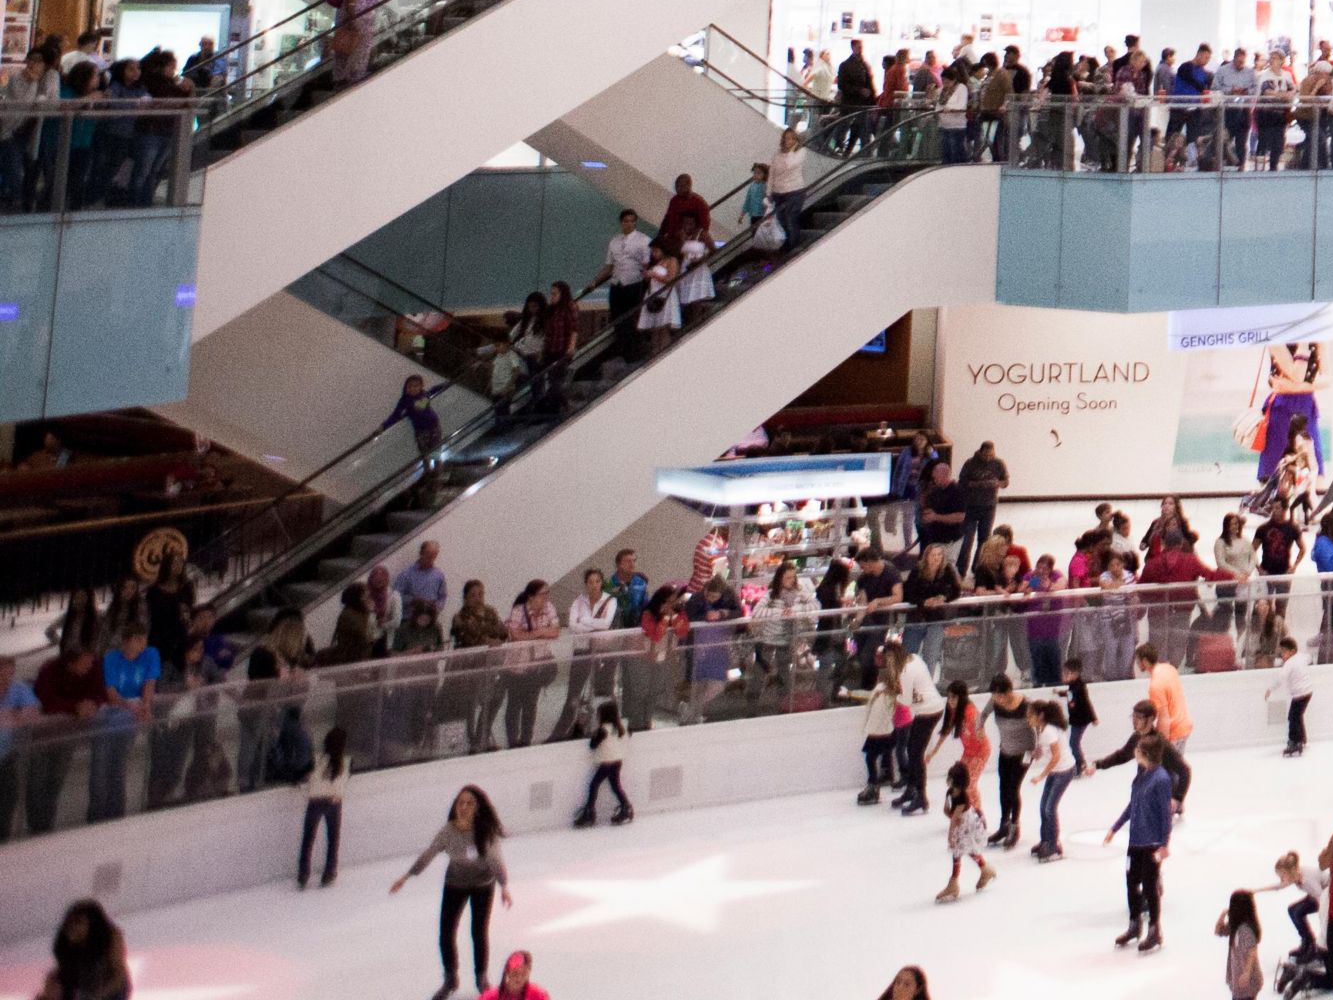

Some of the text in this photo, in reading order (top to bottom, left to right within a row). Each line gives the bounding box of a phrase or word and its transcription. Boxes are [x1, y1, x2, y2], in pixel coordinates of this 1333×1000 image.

[1180, 331, 1272, 348] GENGHIS GRILL
[967, 362, 1150, 385] YOGURTLAND
[997, 391, 1118, 415] Opening Soon
